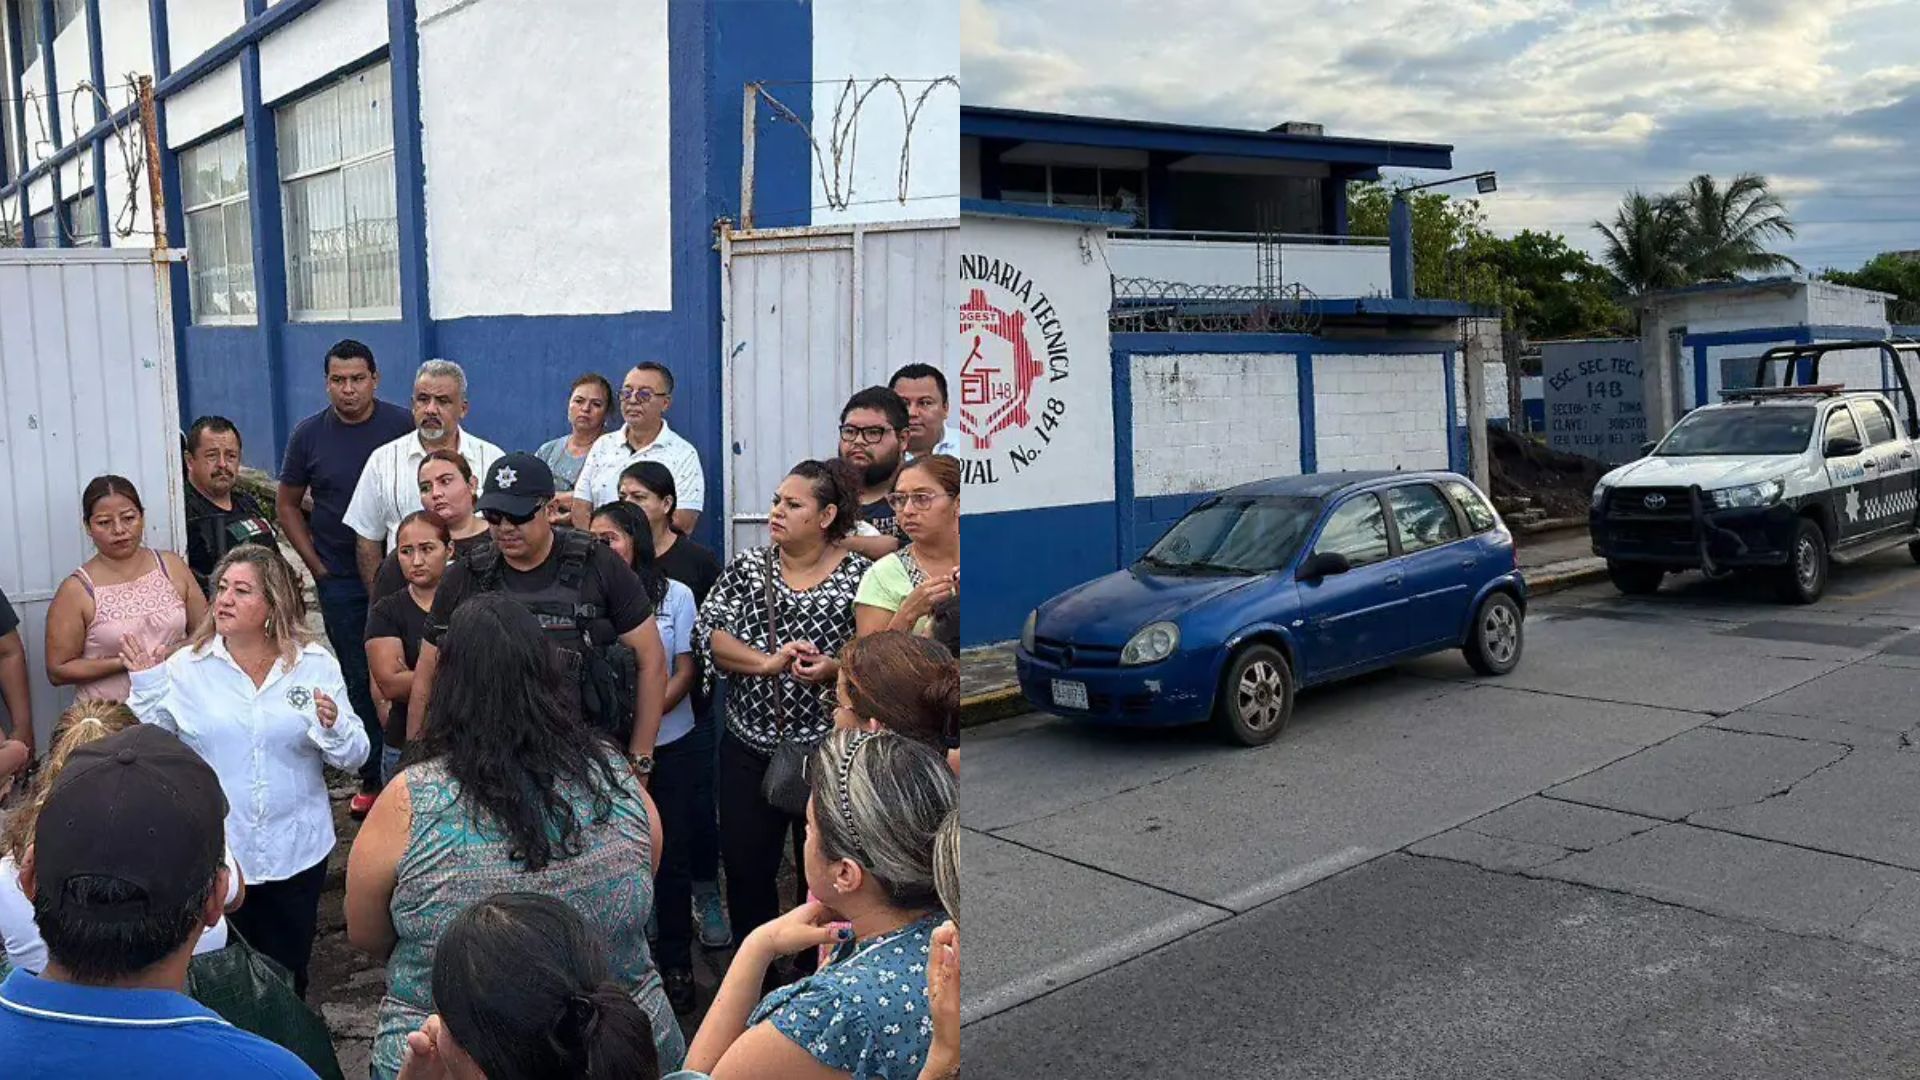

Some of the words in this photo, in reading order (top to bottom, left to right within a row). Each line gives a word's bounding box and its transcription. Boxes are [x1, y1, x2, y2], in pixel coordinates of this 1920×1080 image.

[960, 254, 1033, 304] NDARIA
[1030, 292, 1069, 383] TECNICA
[991, 382, 1012, 401] 148
[1587, 381, 1624, 398] 148
[1008, 445, 1042, 474] No.
[1034, 398, 1066, 444] 148
